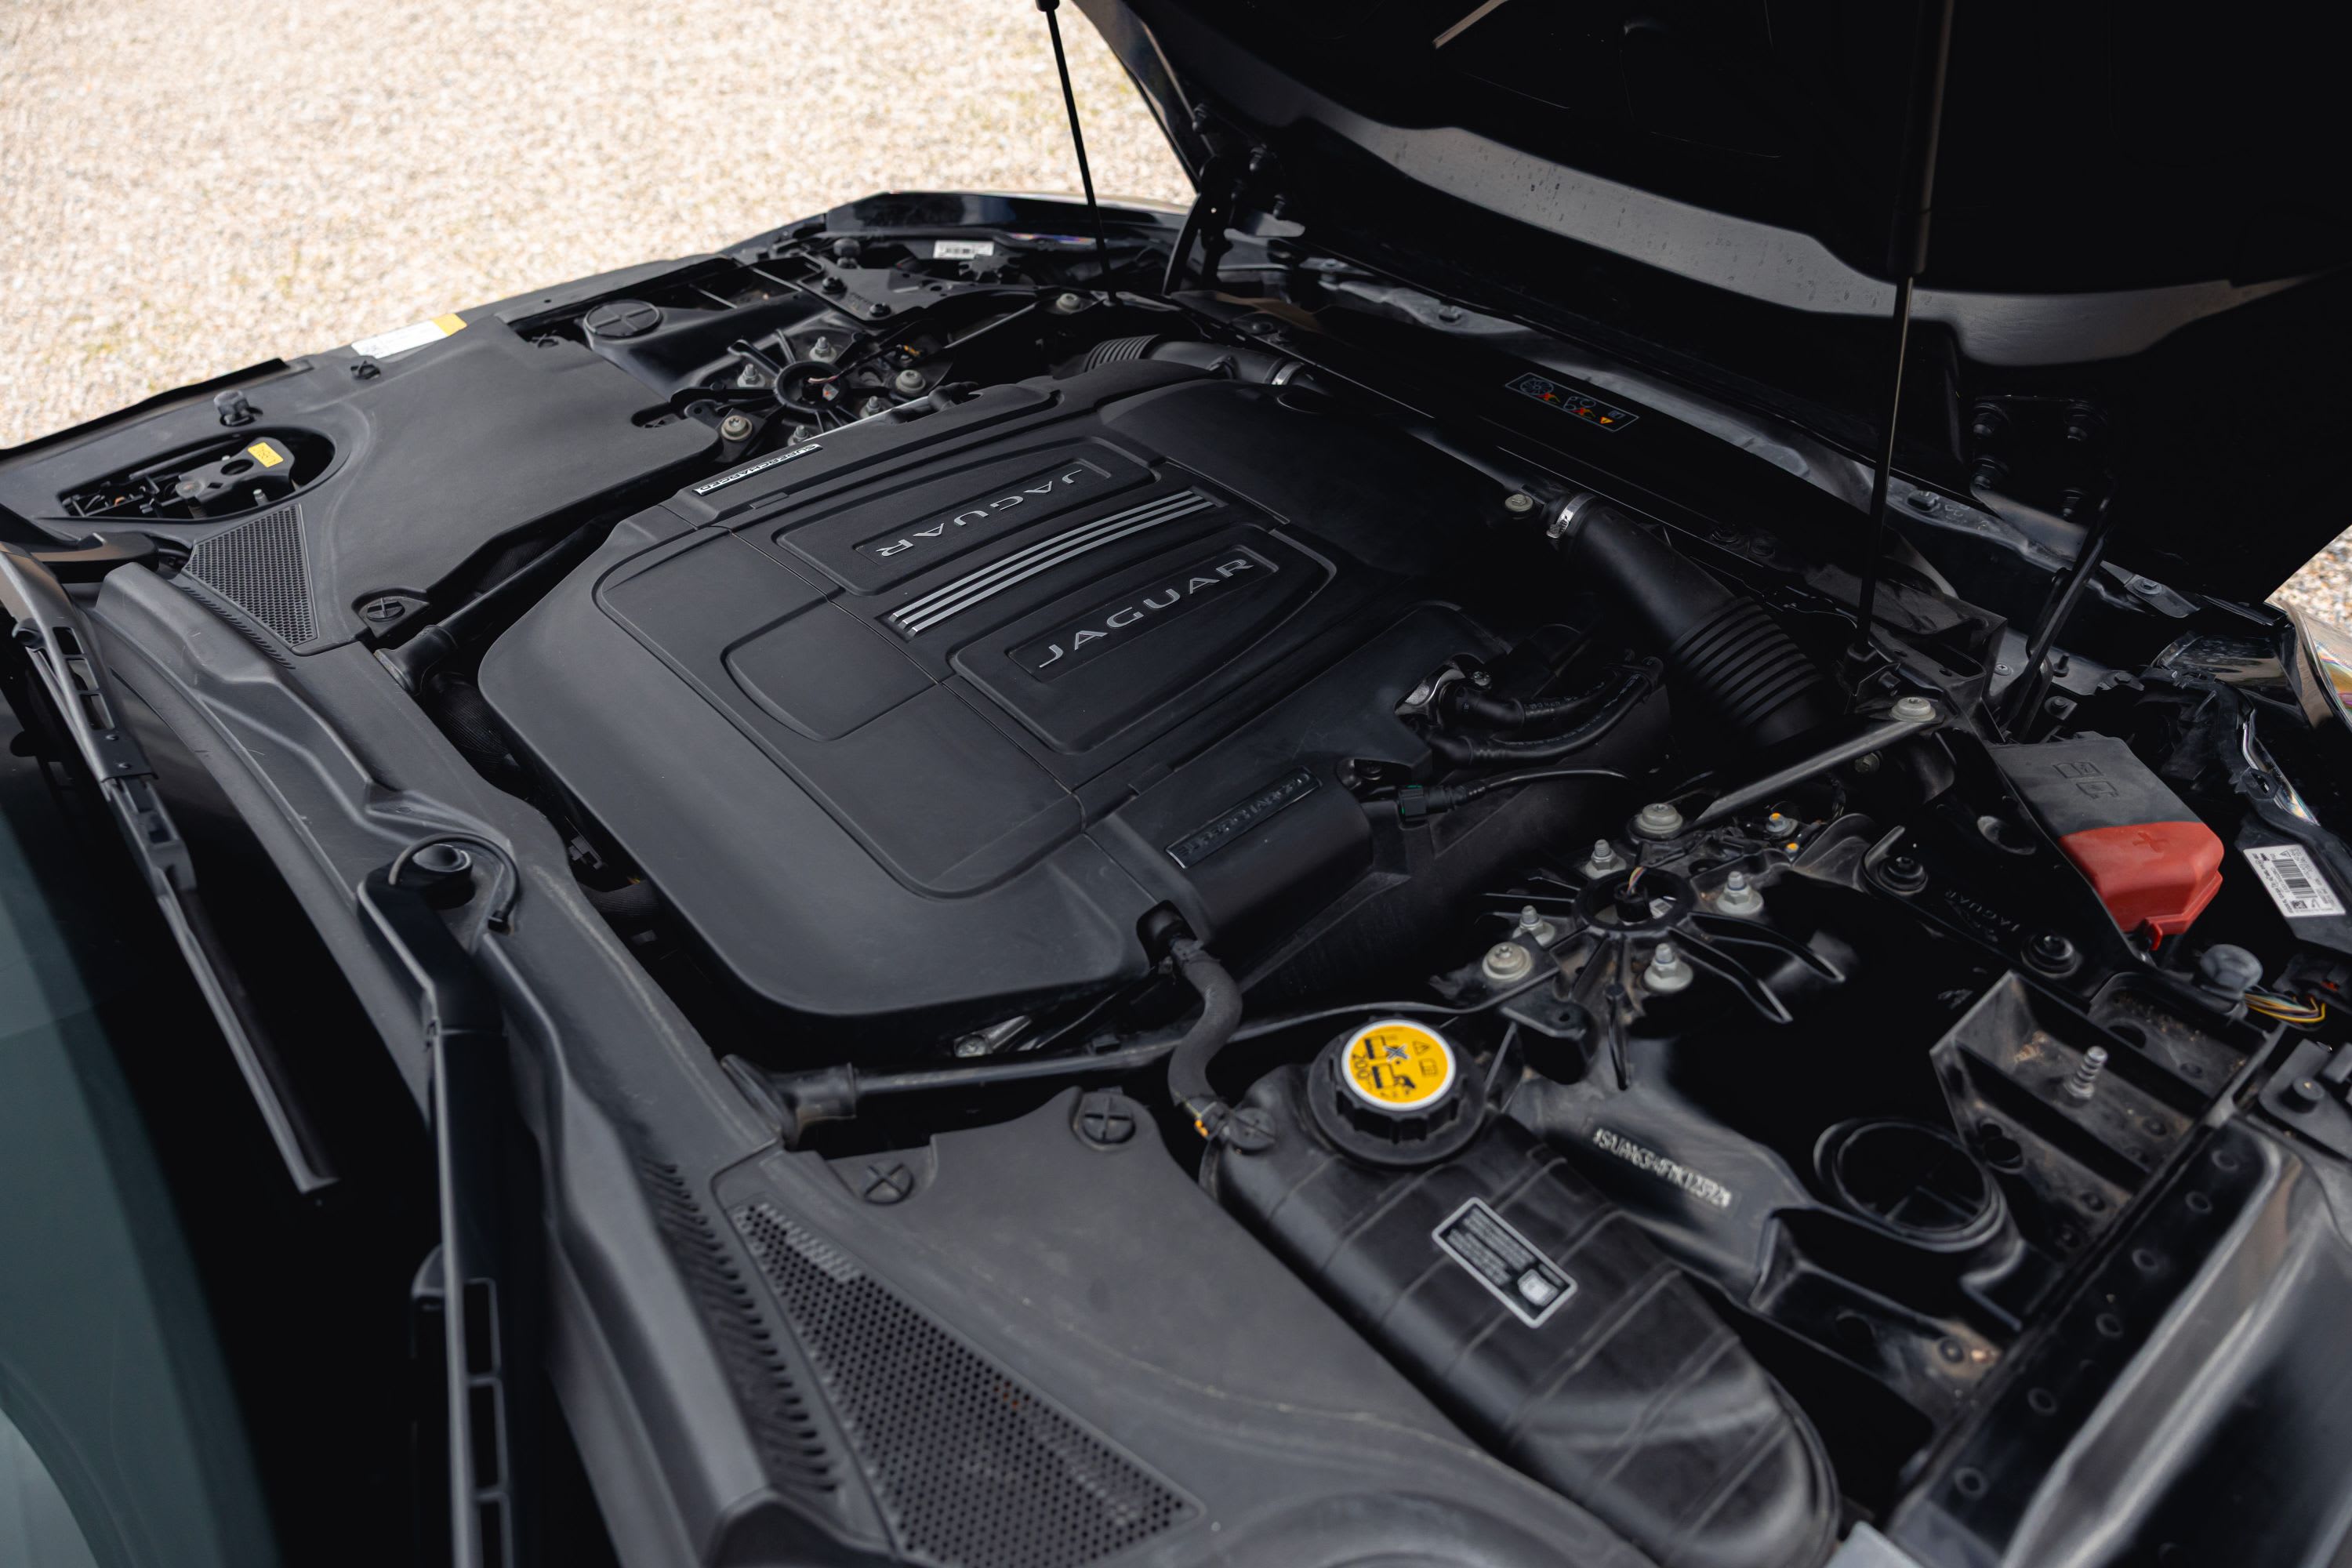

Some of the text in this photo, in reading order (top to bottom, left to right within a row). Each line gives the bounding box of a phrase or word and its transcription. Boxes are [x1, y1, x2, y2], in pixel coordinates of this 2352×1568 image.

[700, 443, 817, 491] SUPERCHARGED
[876, 469, 1083, 557] JAGUAR
[1039, 559, 1254, 668] JAGUAR
